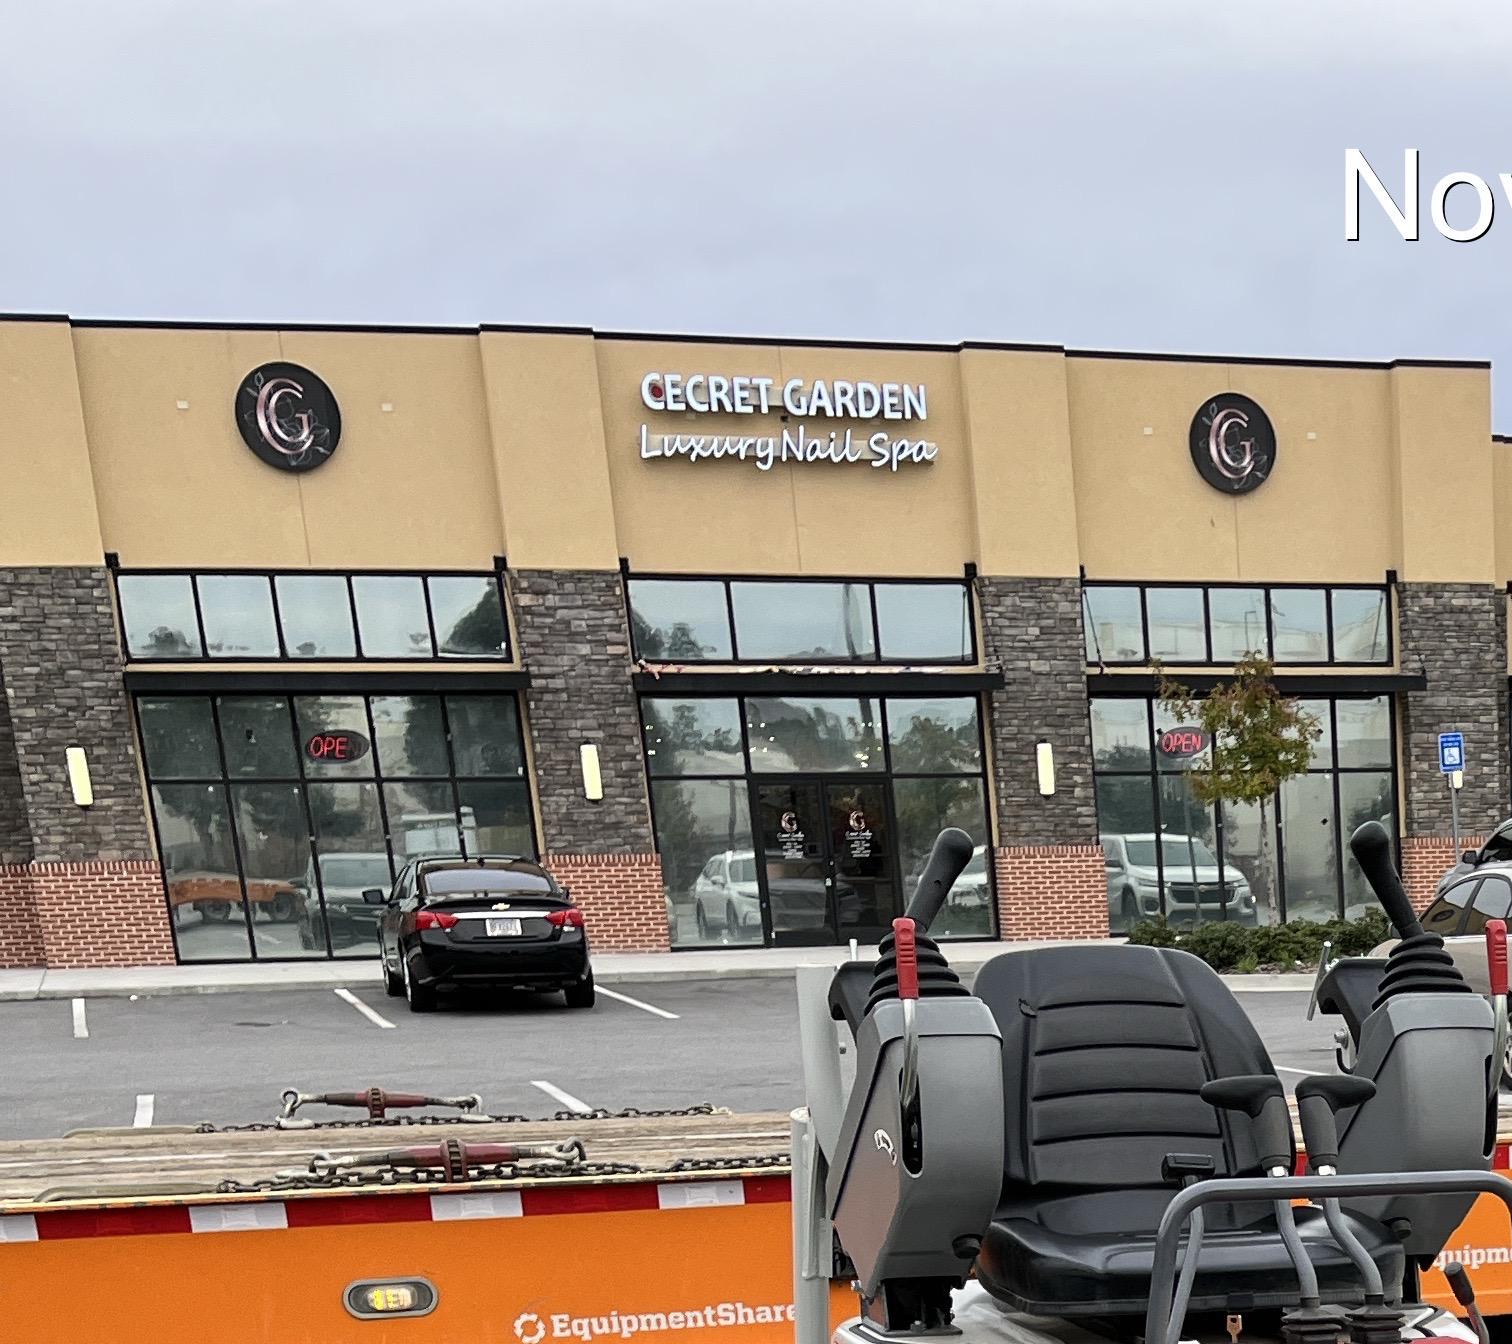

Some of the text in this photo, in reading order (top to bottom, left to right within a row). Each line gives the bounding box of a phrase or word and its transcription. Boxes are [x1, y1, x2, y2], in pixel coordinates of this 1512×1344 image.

[640, 372, 928, 421] CECRET GARDEN
[640, 424, 939, 472] Luxury Nail Spa
[1162, 732, 1202, 753] OPEN
